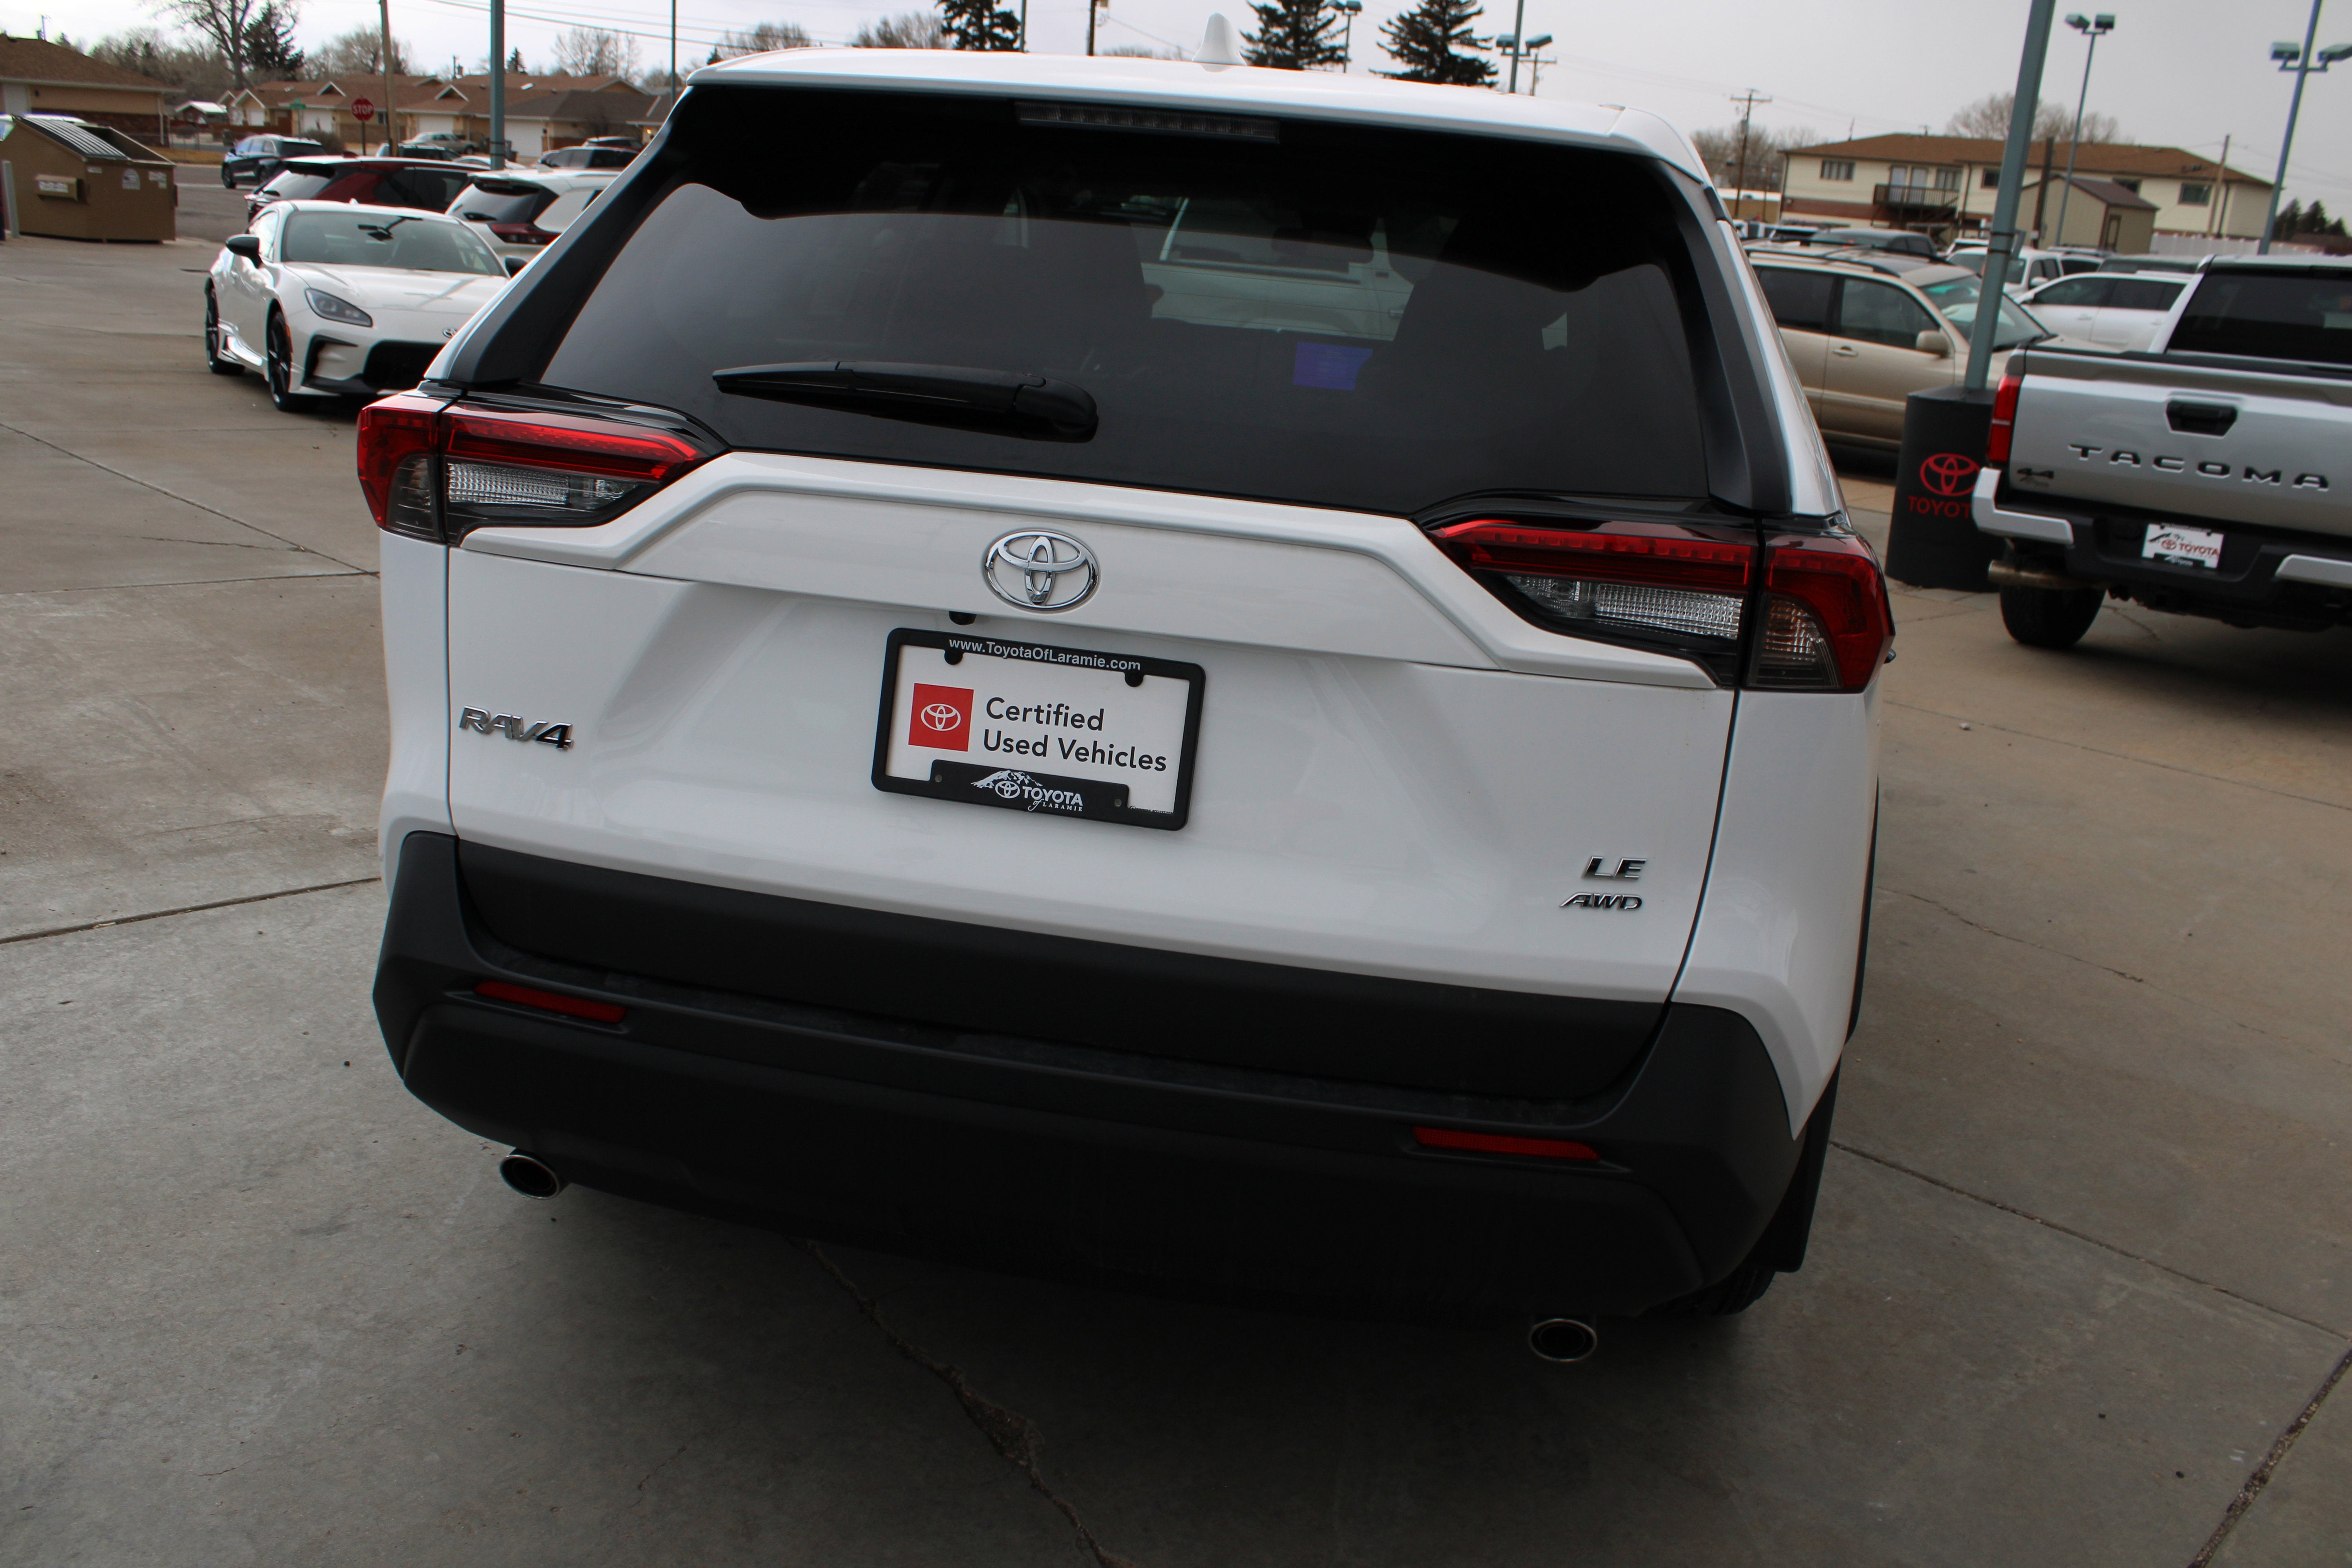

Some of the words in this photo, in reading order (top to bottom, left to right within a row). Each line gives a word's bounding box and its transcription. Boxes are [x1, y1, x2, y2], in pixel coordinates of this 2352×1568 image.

[353, 105, 373, 115] STOP
[2068, 443, 2329, 492] TACOMA
[1908, 495, 1974, 519] TOYOT
[2179, 543, 2218, 555] TOYOTA
[949, 639, 1141, 671] www.ToyotaOfLaramie.com
[986, 697, 1104, 731] Certified
[459, 705, 573, 751] RAV4
[983, 728, 1049, 757] Used
[1058, 737, 1167, 772] Vehicles
[1022, 786, 1083, 806] TOYOTA
[1027, 798, 1045, 811] of
[1042, 801, 1083, 812] LARAMIE
[1581, 856, 1647, 880] LE
[1559, 892, 1642, 910] AWD
